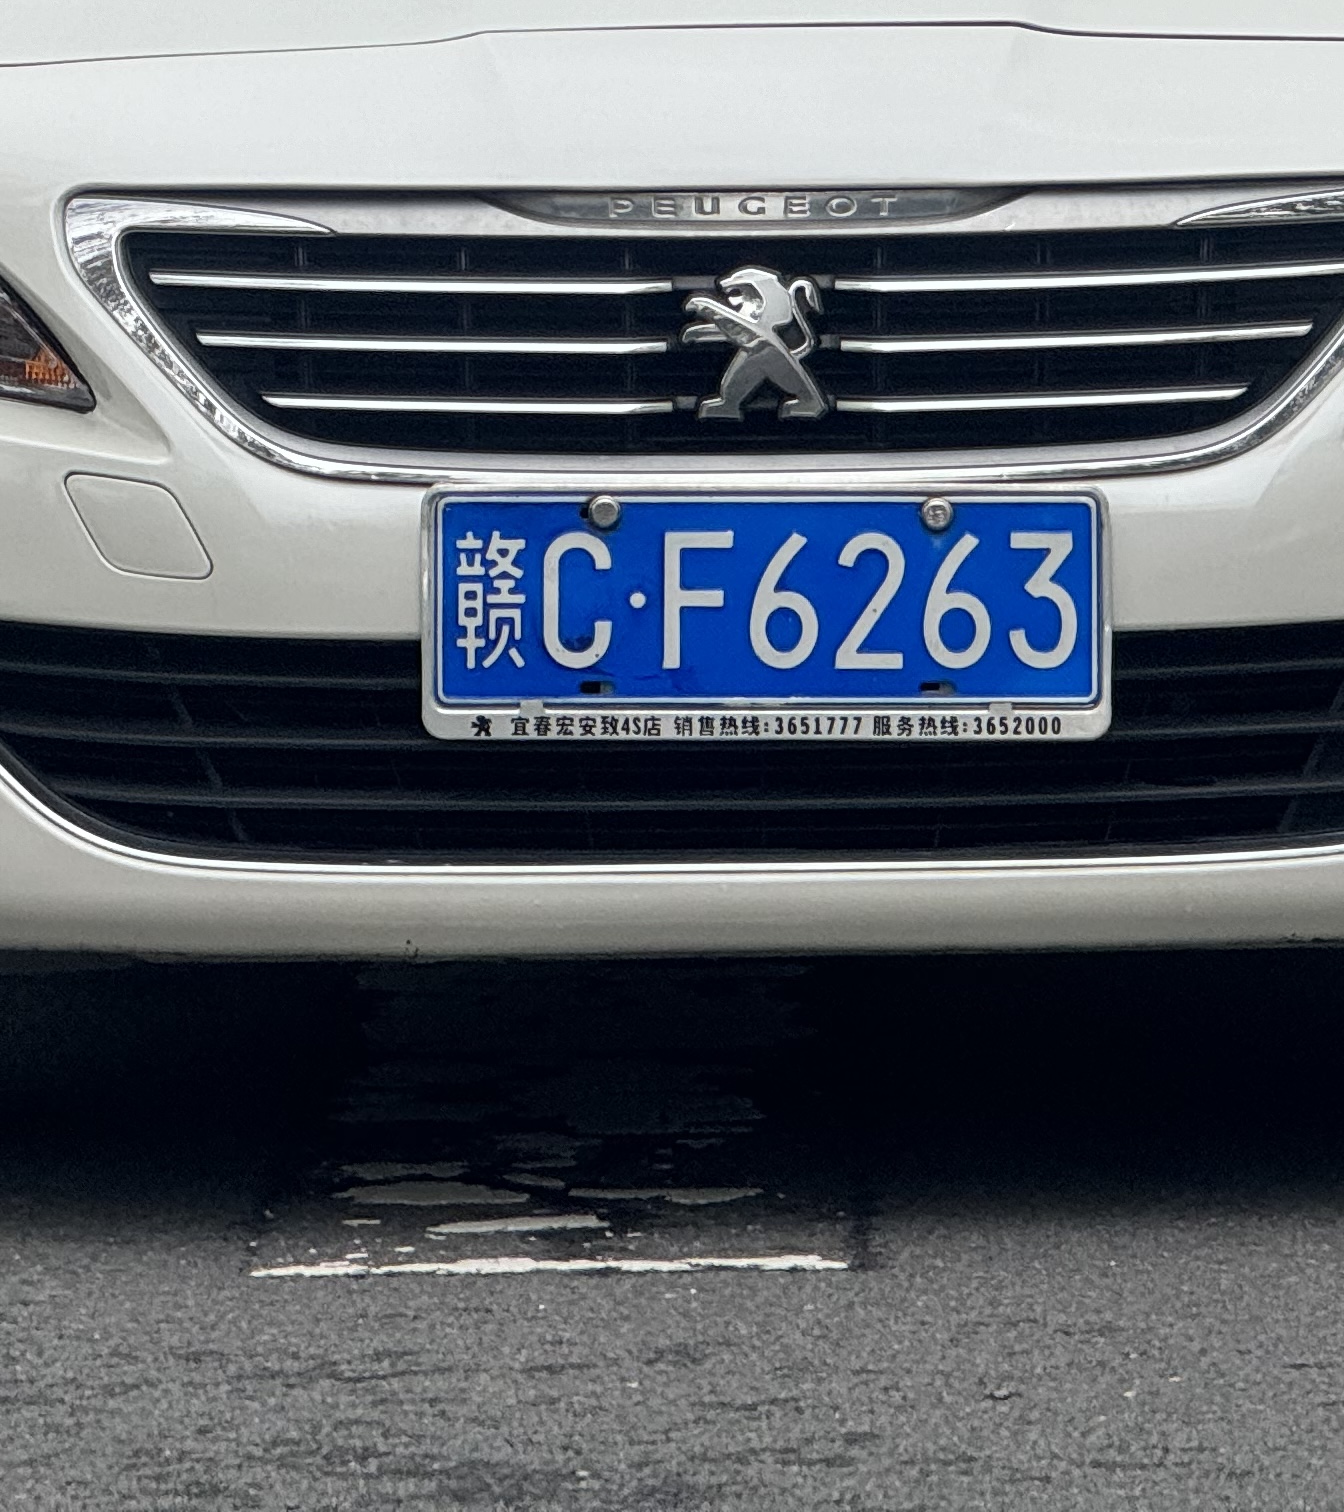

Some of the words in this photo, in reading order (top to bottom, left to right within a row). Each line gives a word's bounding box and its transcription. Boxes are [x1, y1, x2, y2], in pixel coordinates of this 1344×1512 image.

[608, 194, 897, 219] PEUGEOT
[510, 715, 662, 737] 宜春宏安致4S店
